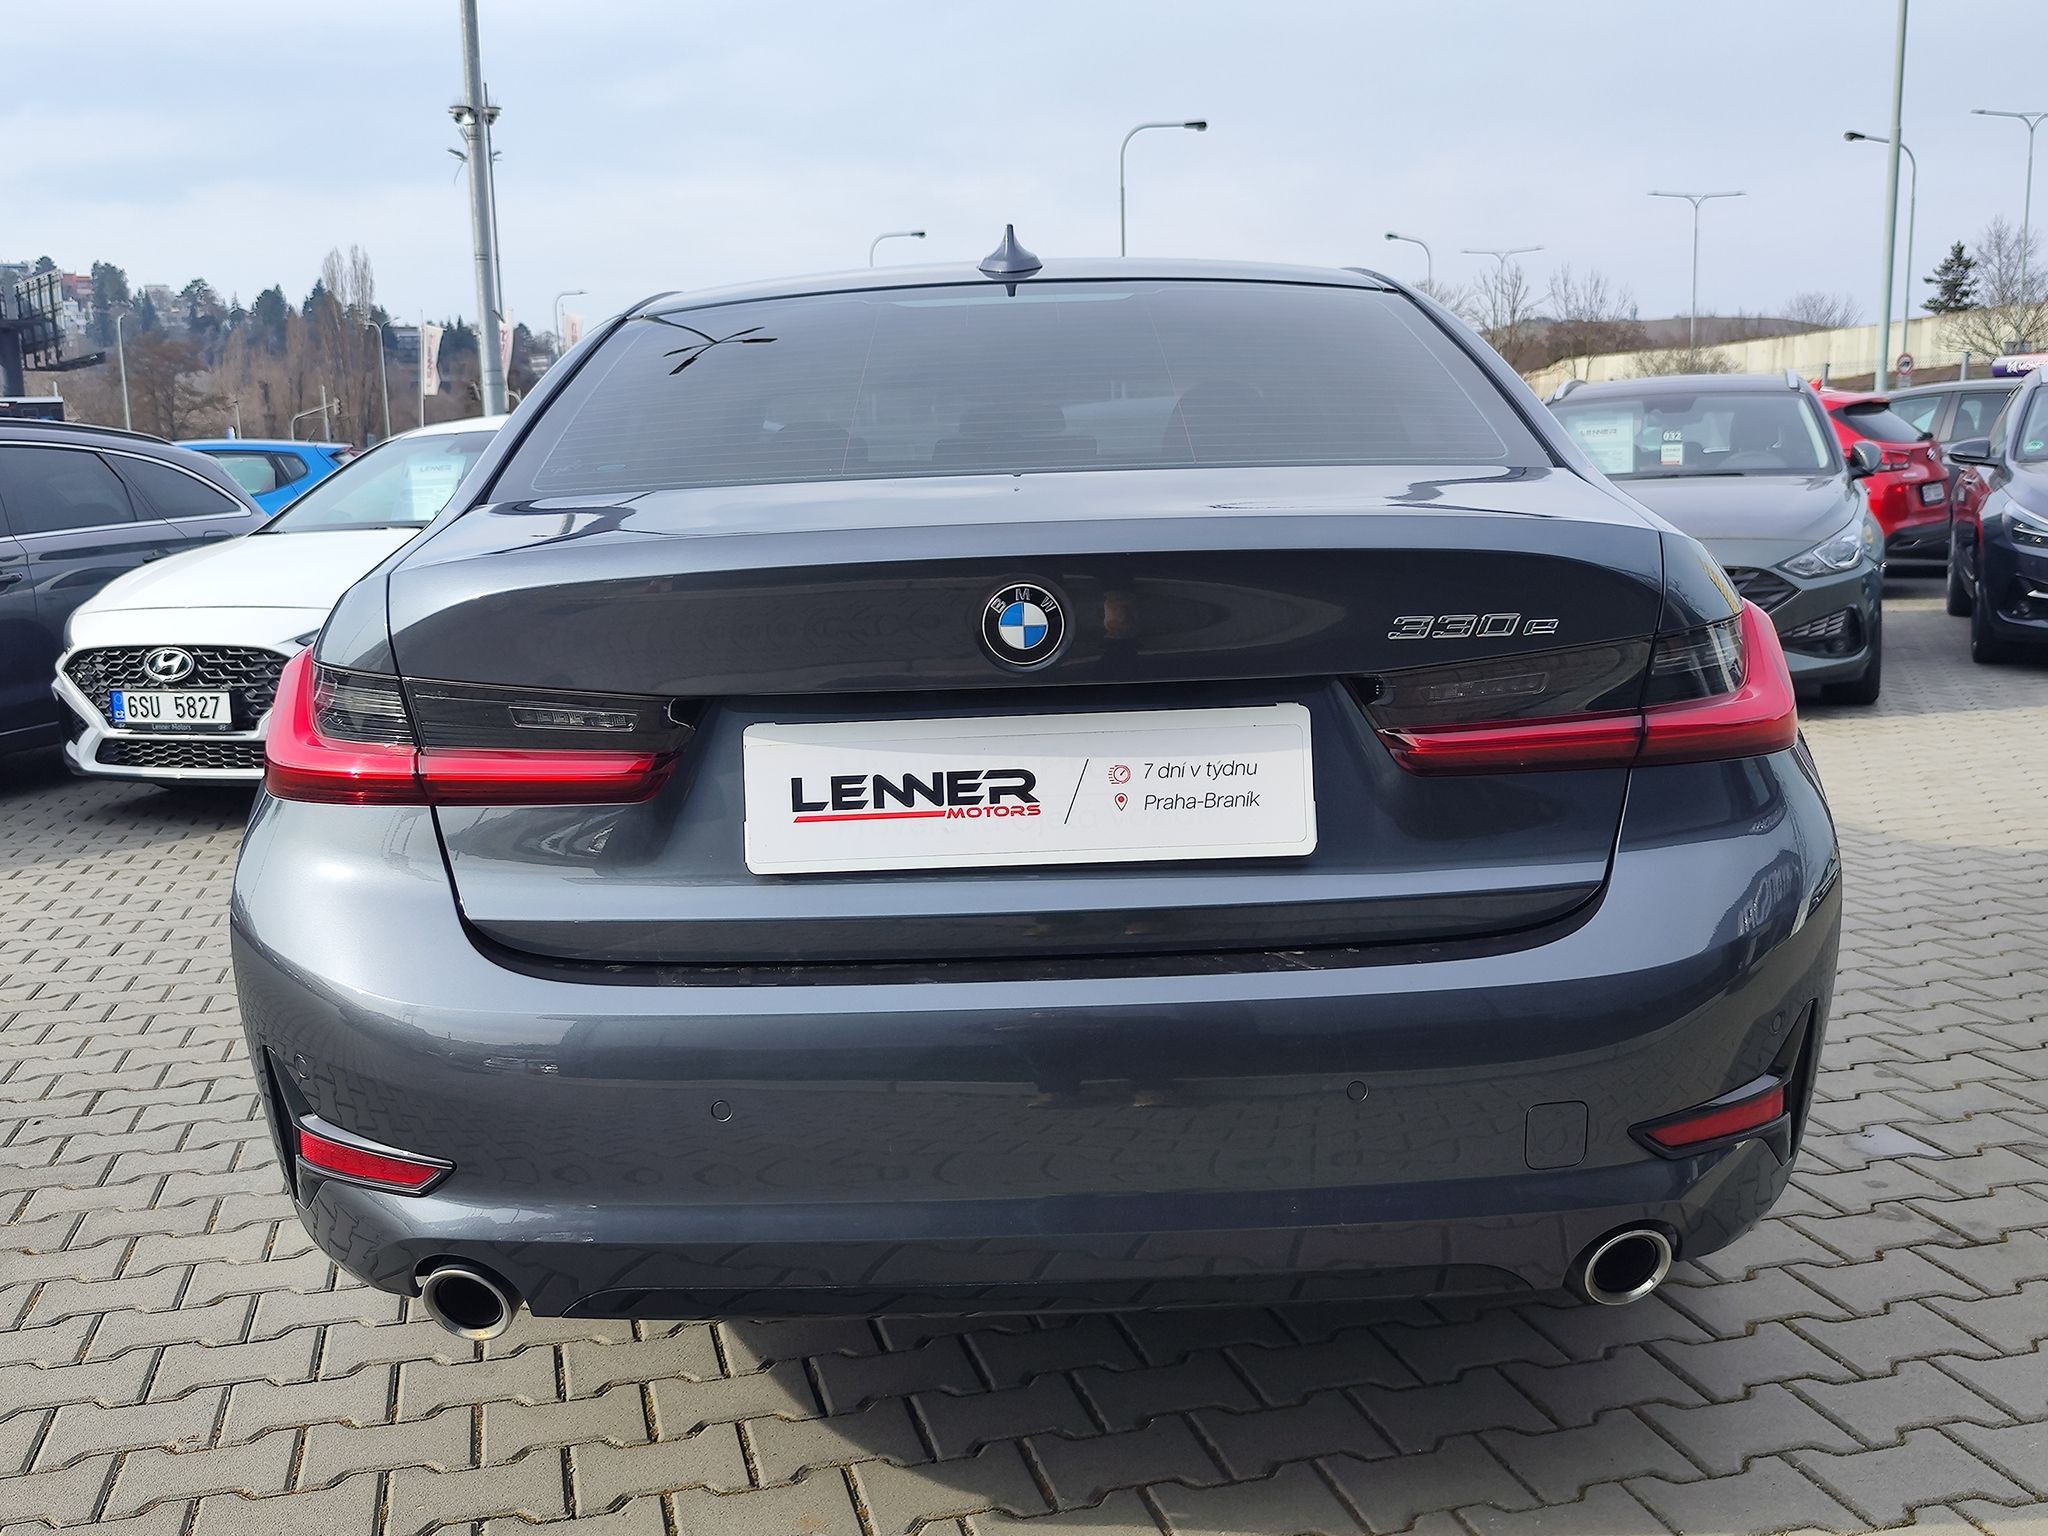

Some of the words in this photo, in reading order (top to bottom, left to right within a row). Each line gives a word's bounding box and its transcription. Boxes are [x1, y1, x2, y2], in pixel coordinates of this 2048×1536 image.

[990, 587, 1057, 614] BMW
[127, 695, 161, 719] 6SU
[174, 695, 220, 719] 5827
[1144, 762, 1154, 780] 7
[1157, 761, 1187, 779] dní
[1190, 764, 1202, 778] v
[1206, 760, 1258, 781] týdnu
[791, 768, 1041, 813] LENNER
[1144, 790, 1261, 811] Praha-Braník
[946, 804, 1042, 820] MOTORS
